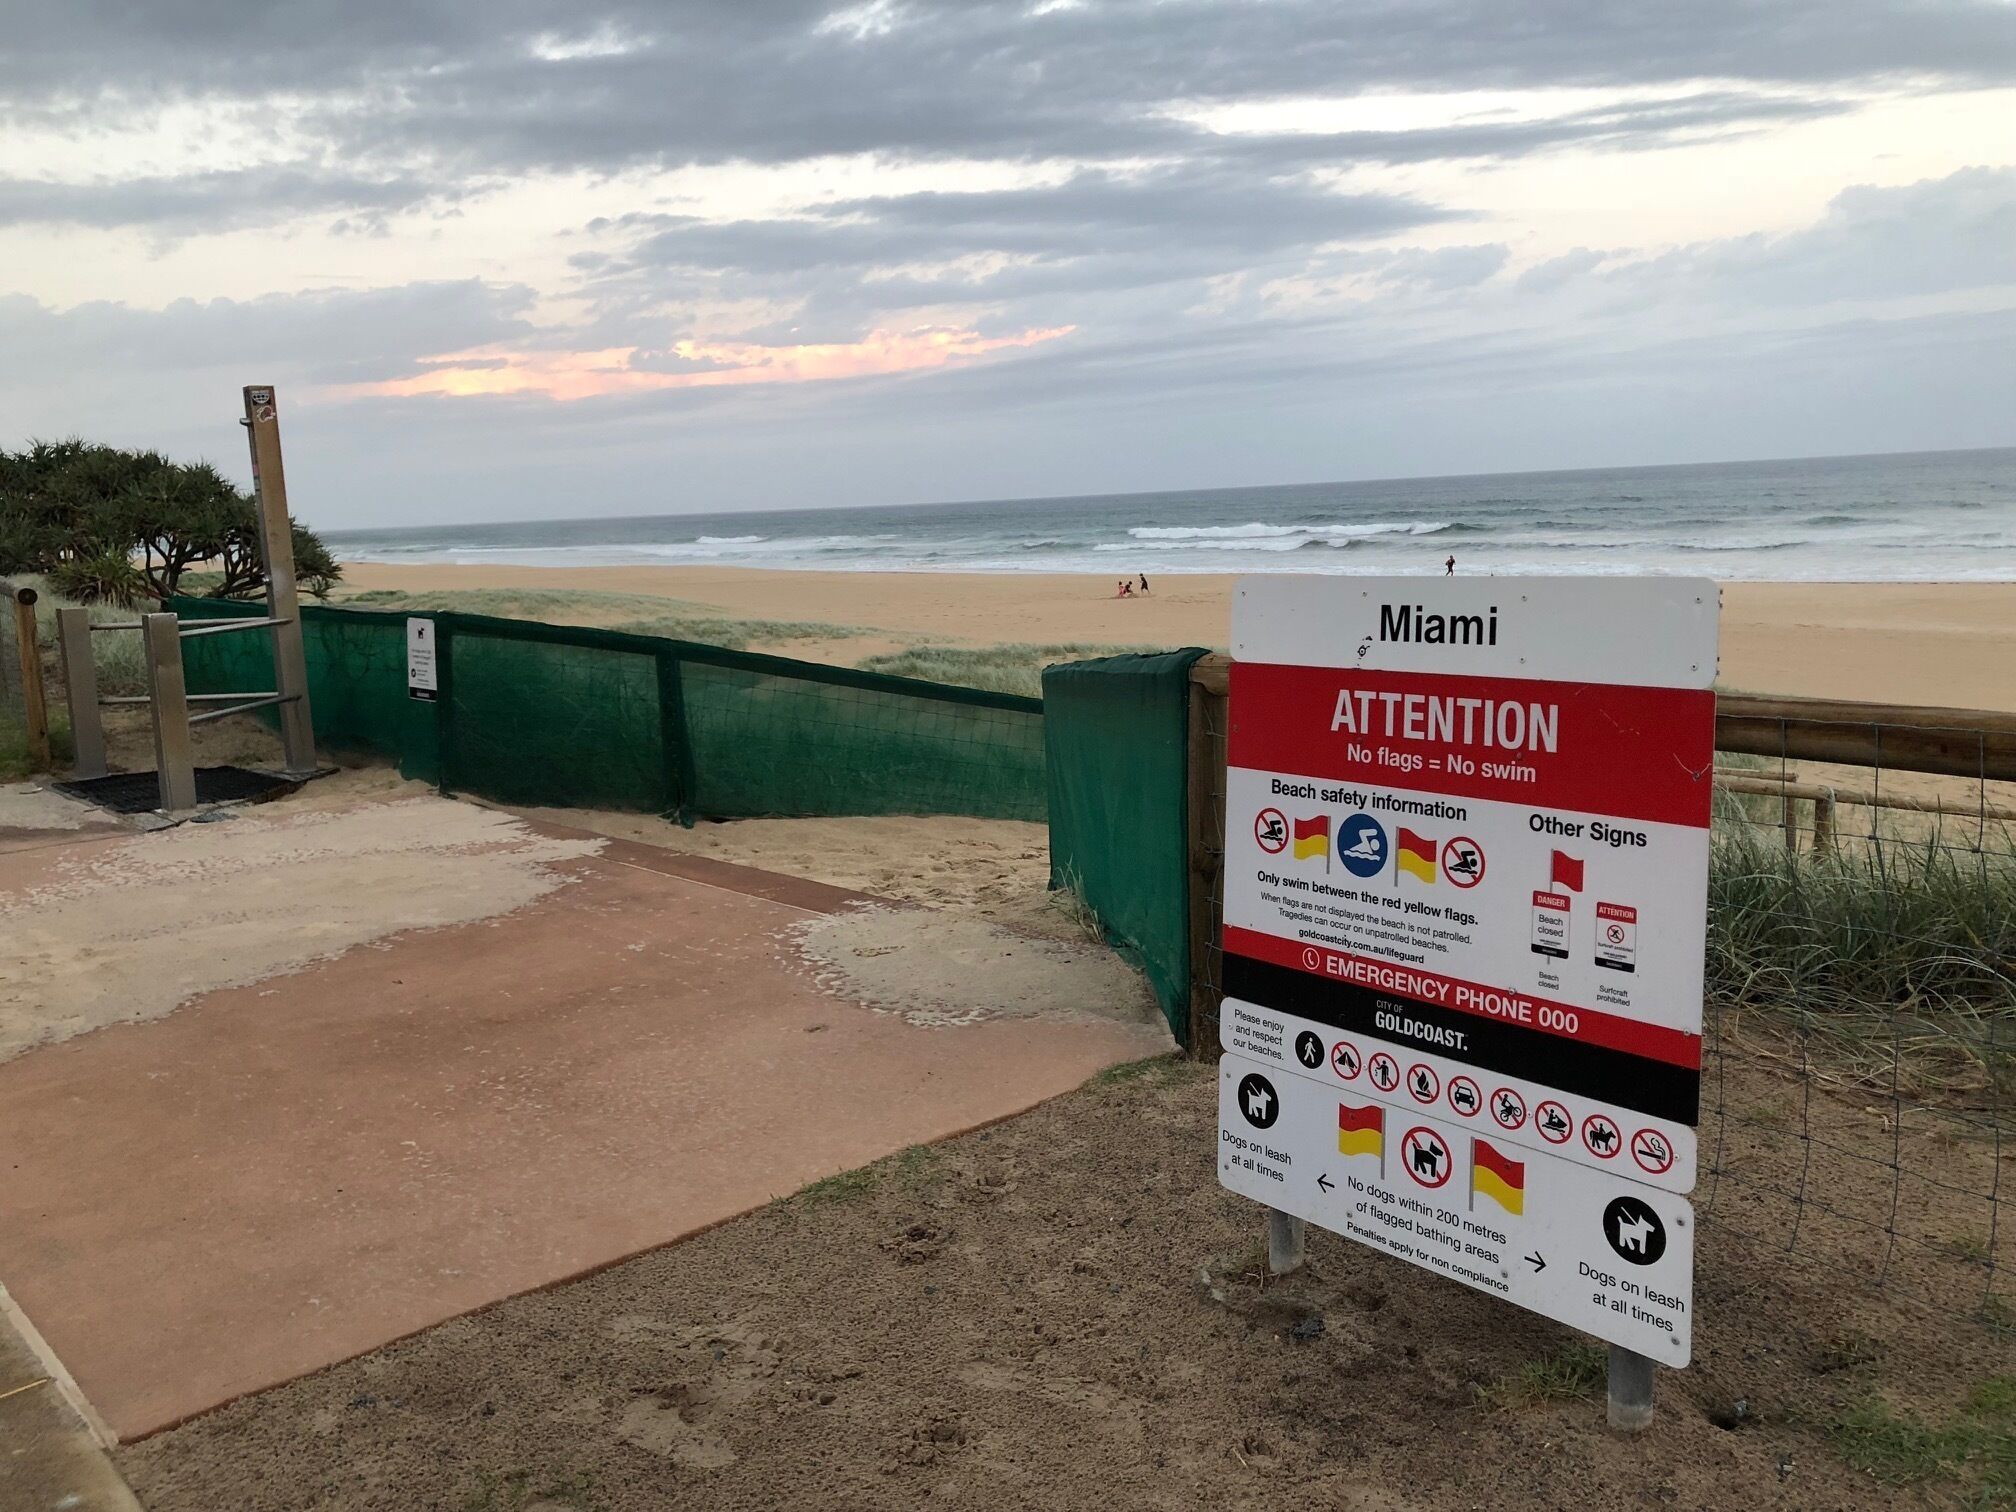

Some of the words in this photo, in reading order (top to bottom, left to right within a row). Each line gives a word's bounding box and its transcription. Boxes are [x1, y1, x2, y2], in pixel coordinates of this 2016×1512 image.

[1380, 605, 1498, 645] Miami
[1331, 689, 1558, 753] ATTENTION
[1347, 744, 1372, 763] No
[1378, 746, 1422, 772] flags
[1429, 759, 1441, 770] =
[1448, 754, 1474, 776] No
[1481, 763, 1536, 782] swim
[1272, 779, 1315, 799] Beach
[1321, 788, 1367, 809] safety
[1372, 793, 1466, 821] information
[1530, 814, 1584, 837] Other
[1590, 822, 1647, 847] Signs
[1258, 871, 1279, 887] Only
[1283, 877, 1309, 890] swim
[1312, 880, 1357, 901] between
[1361, 891, 1378, 905] the
[1382, 895, 1400, 909] red
[1404, 900, 1441, 917] yellow
[1445, 908, 1478, 925] flags.
[1538, 896, 1565, 907] DANGER
[1599, 907, 1634, 919] ATTENTION
[1261, 892, 1280, 903] When
[1282, 895, 1299, 908] flags
[1301, 902, 1312, 910] are
[1315, 903, 1326, 913] not
[1329, 905, 1364, 922] displayed
[1367, 914, 1379, 924] the
[1381, 917, 1405, 930] beach
[1408, 922, 1414, 931] is
[1417, 925, 1430, 935] not
[1433, 927, 1472, 944] patrolled.
[1278, 908, 1312, 923] Tragedies
[1314, 916, 1328, 925] can
[1330, 919, 1351, 931] occur
[1354, 924, 1363, 933] on
[1366, 926, 1409, 944] unpatrolled
[1412, 936, 1449, 952] beaches.
[1538, 926, 1563, 937] closed
[1539, 914, 1563, 926] Beach
[1299, 928, 1424, 964] goldcoastcity.com.au/lifeguard
[1538, 981, 1559, 990] closed
[1539, 971, 1559, 981] Beach
[1600, 985, 1628, 997] Surfcraft
[1327, 956, 1449, 1001] EMERGENCY
[1456, 986, 1531, 1022] PHONE
[1538, 1007, 1578, 1033] 000
[1376, 1000, 1392, 1011] CITY
[1394, 1004, 1403, 1013] OF
[1597, 994, 1630, 1006] prohibited
[1235, 1009, 1260, 1025] Please
[1263, 1018, 1284, 1034] enjoy
[1236, 1025, 1250, 1036] and
[1253, 1030, 1282, 1046] respect
[1233, 1039, 1245, 1048] our
[1248, 1042, 1284, 1061] beaches.
[1223, 1130, 1247, 1149] Dogs
[1250, 1142, 1262, 1154] on
[1265, 1145, 1292, 1165] leash
[1232, 1154, 1240, 1165] at
[1244, 1158, 1254, 1170] all
[1257, 1163, 1284, 1182] times
[1348, 1176, 1363, 1192] No
[1367, 1181, 1395, 1204] dogs
[1399, 1196, 1433, 1218] within
[1437, 1209, 1459, 1227] 200
[1464, 1220, 1507, 1245] metres
[1356, 1202, 1367, 1213] of
[1370, 1205, 1412, 1231] flagged
[1417, 1223, 1461, 1252] bathing
[1465, 1243, 1499, 1264] areas
[1347, 1222, 1387, 1245] Penalties
[1389, 1239, 1414, 1257] apply
[1416, 1249, 1429, 1261] for
[1432, 1255, 1449, 1270] non
[1452, 1262, 1509, 1292] compliance
[1579, 1262, 1616, 1287] Dogs
[1621, 1281, 1639, 1295] on
[1645, 1286, 1684, 1312] leash
[1593, 1293, 1606, 1307] at
[1611, 1300, 1626, 1314] all
[1632, 1306, 1673, 1332] times
